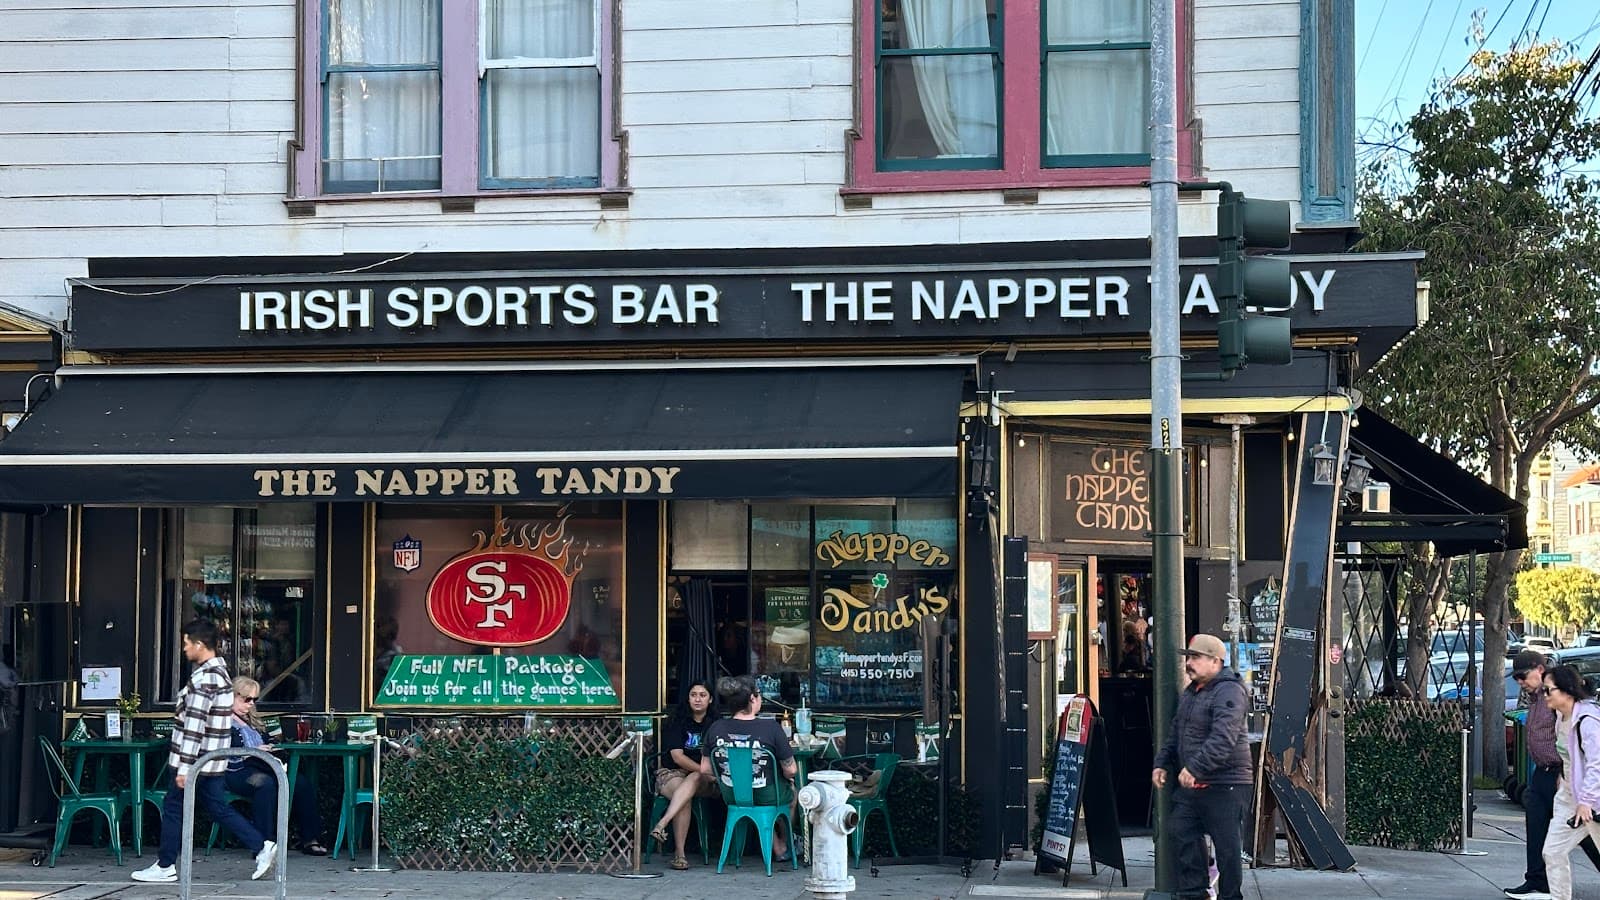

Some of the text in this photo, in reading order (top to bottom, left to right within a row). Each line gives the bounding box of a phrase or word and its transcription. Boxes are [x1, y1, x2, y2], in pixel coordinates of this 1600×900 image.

[240, 284, 719, 330] IRISH SPORTS BAR
[790, 281, 894, 321] THE
[911, 276, 1129, 320] NAPPER
[1091, 447, 1145, 476] THE
[253, 467, 681, 496] THE NAPPER TANDY
[1065, 474, 1150, 503] NAPPE
[396, 551, 418, 567] NFL
[816, 530, 950, 568] Napper
[411, 656, 586, 685] Full NFL Package
[386, 680, 418, 696] Join
[422, 684, 440, 696] us
[445, 680, 467, 696] for
[472, 680, 493, 696] all
[502, 680, 526, 696] the
[530, 682, 577, 700] games
